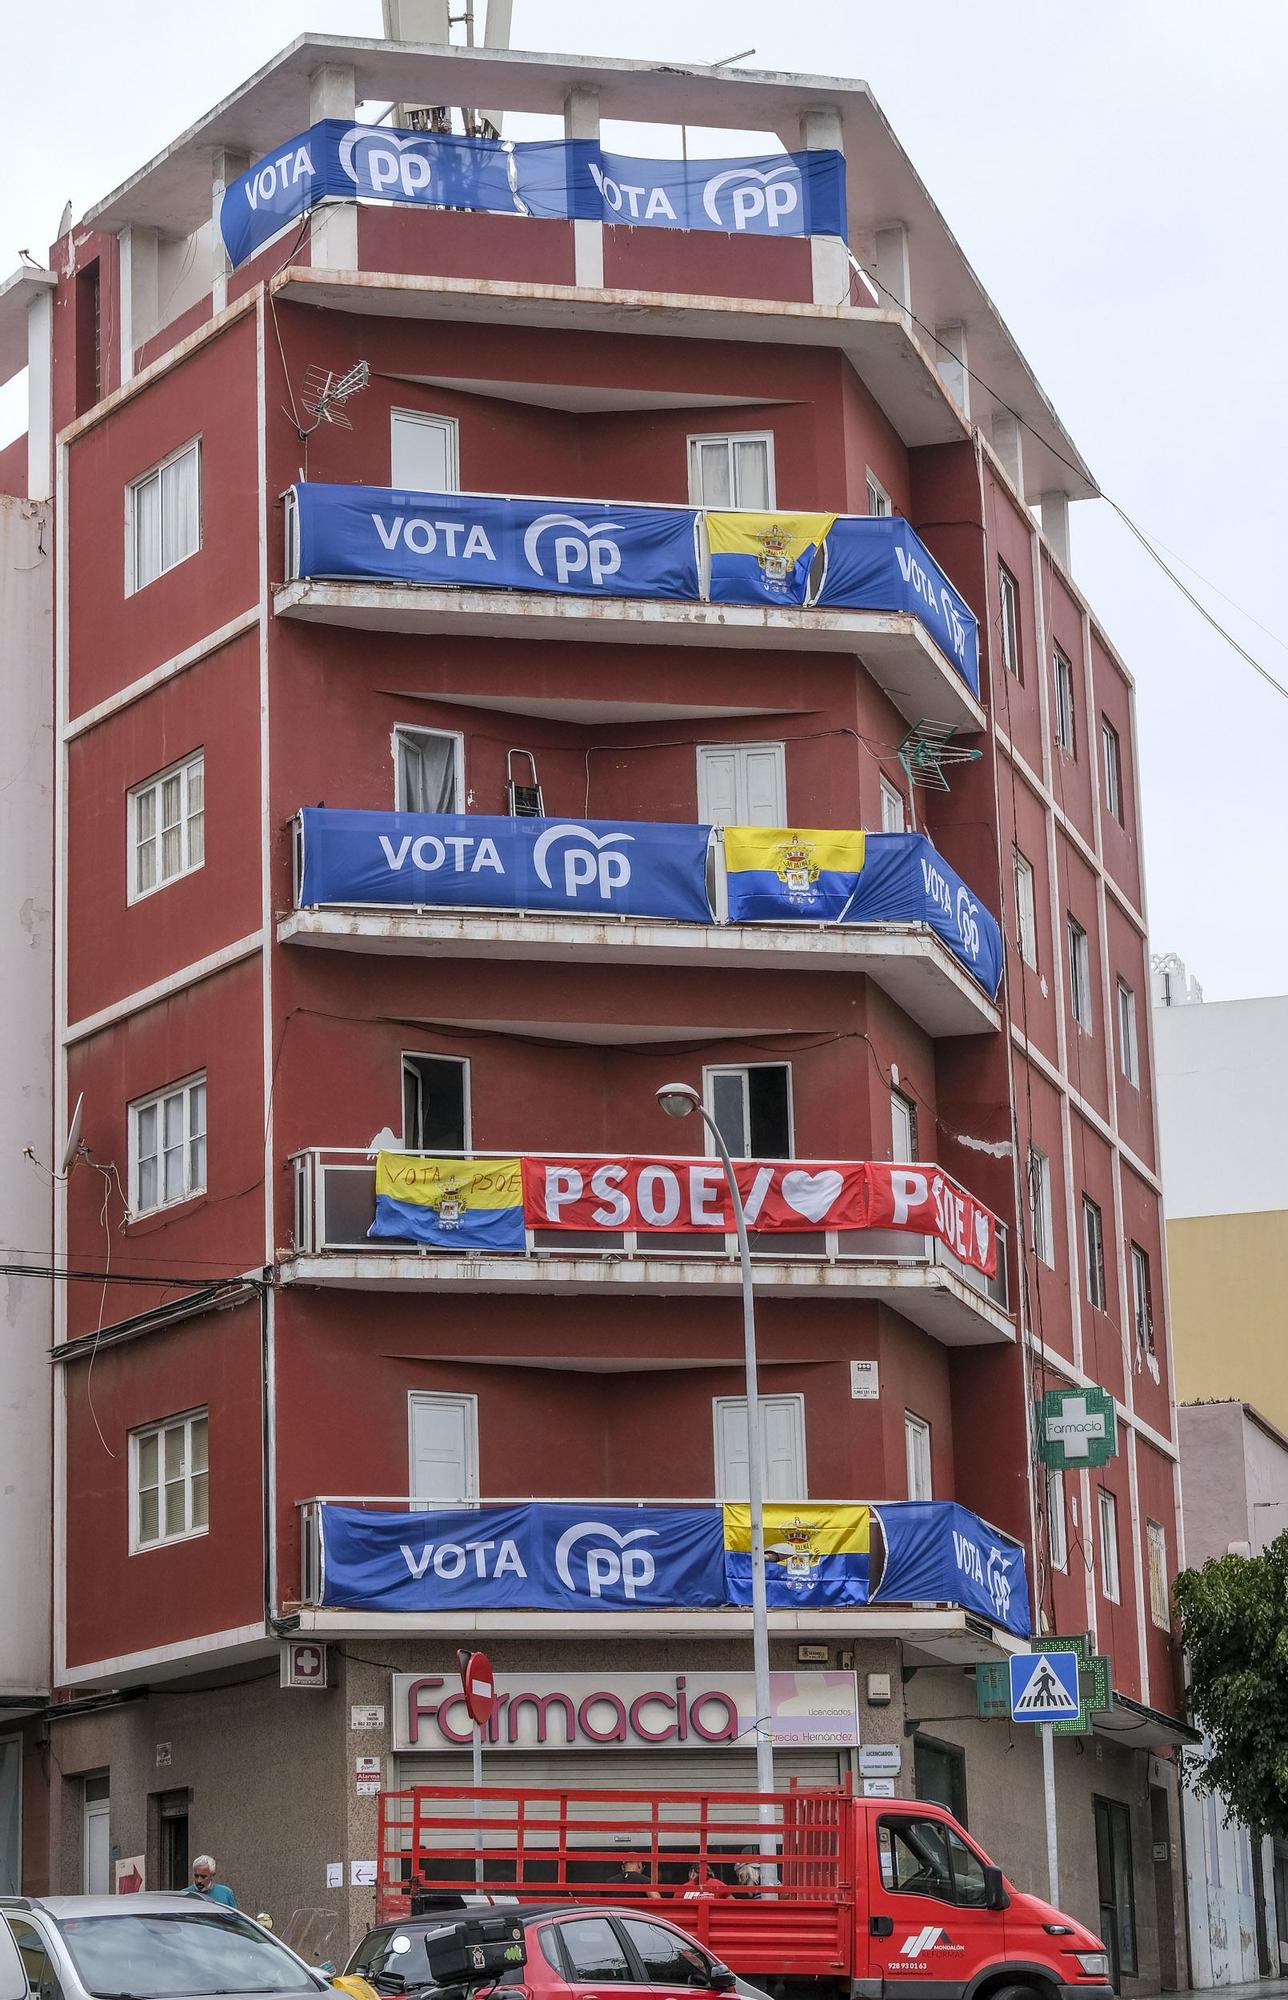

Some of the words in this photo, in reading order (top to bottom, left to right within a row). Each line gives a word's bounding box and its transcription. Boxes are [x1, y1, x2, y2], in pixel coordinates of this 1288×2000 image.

[245, 146, 316, 211] VOTA
[372, 513, 496, 561] VOTA
[895, 547, 939, 615] VOTA
[379, 835, 505, 874] VOTA
[920, 858, 953, 919] VOTA
[384, 1165, 441, 1186] VOTA
[470, 1171, 522, 1194] PSOE
[1048, 1420, 1102, 1434] Farmacia
[400, 1540, 527, 1580] VOTA
[952, 1530, 984, 1586] VOTA
[408, 1677, 740, 1745] Farmacia
[808, 1708, 850, 1716] Licenciados
[888, 1962, 901, 1970] 928
[901, 1962, 909, 1970] 93
[909, 1962, 918, 1970] 01
[918, 1962, 927, 1970] 63
